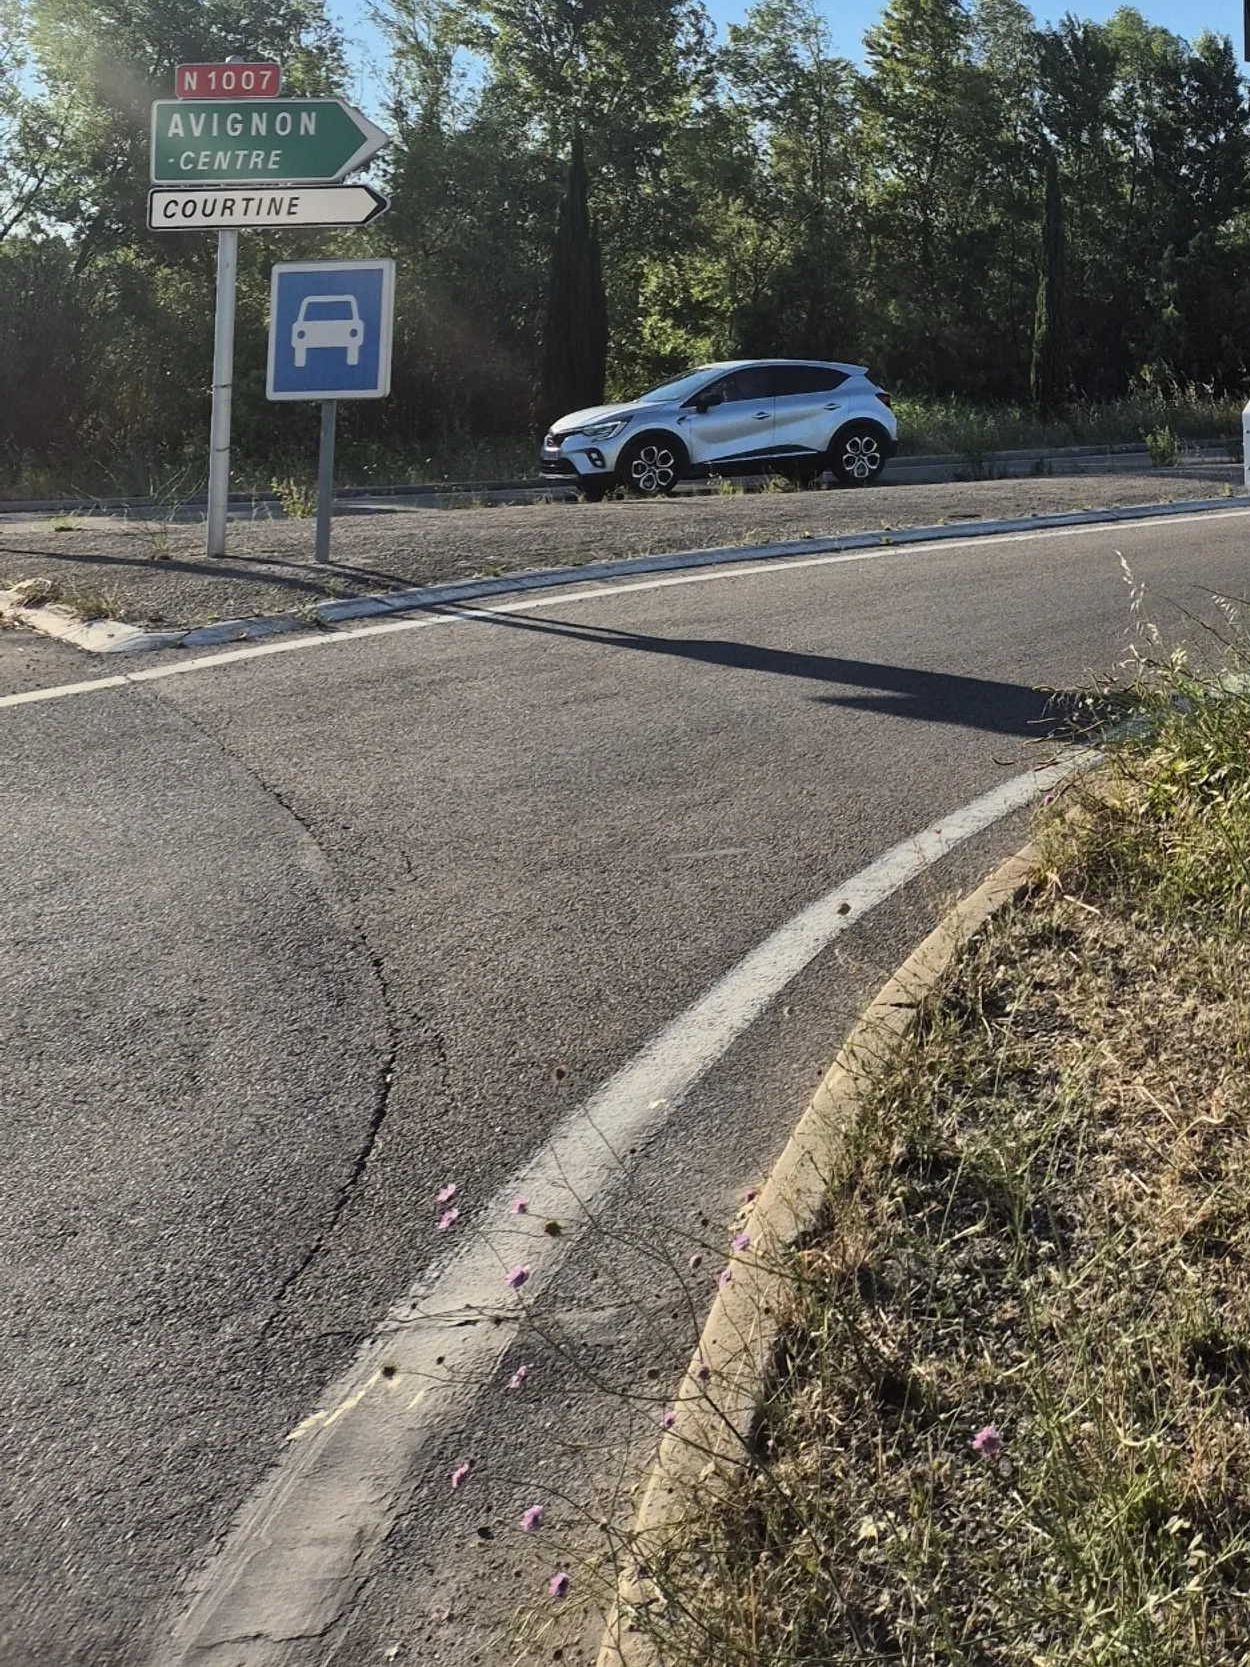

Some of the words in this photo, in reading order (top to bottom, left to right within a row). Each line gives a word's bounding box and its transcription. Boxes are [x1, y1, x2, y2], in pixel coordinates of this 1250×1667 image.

[184, 71, 197, 91] N
[207, 70, 273, 90] 1007
[167, 111, 317, 138] AVIGNON
[163, 197, 301, 219] COURTINE
